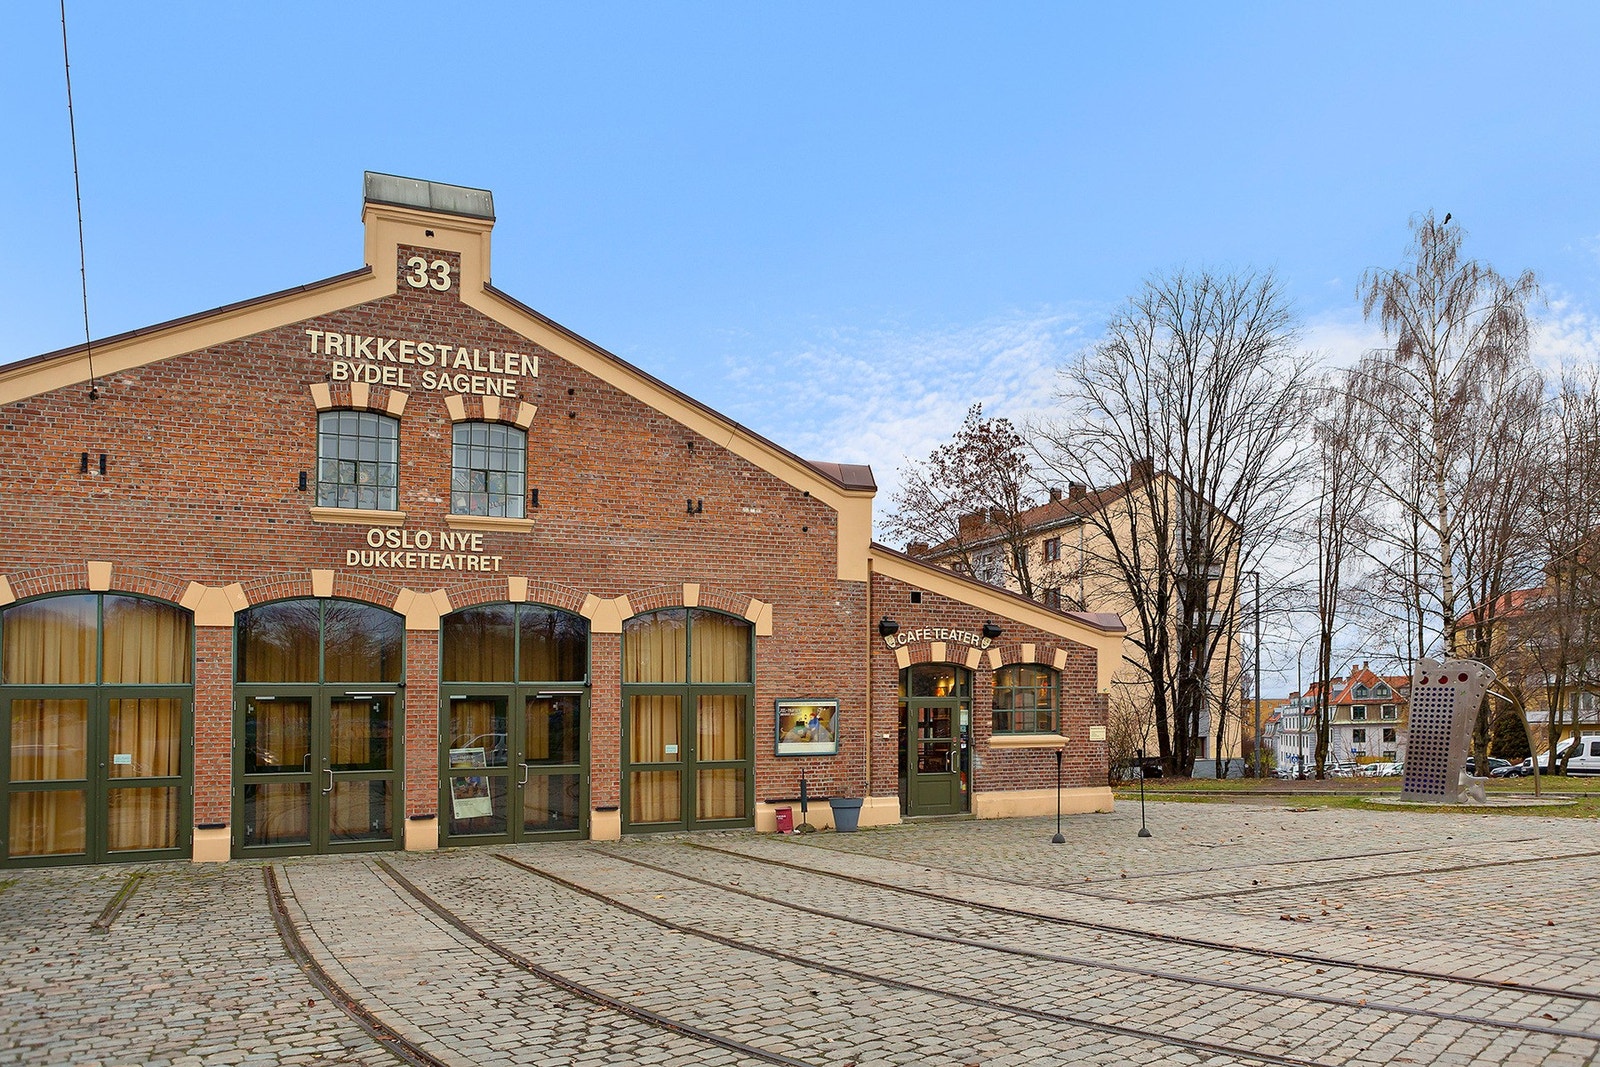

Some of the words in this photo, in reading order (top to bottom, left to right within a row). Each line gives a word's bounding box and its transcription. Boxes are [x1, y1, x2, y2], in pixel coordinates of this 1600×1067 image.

[406, 256, 452, 292] 33
[305, 330, 540, 378] TRIKKESTALLEN
[332, 361, 412, 388] BYDEL
[421, 371, 517, 398] SAGENE
[366, 528, 433, 550] OSLO
[440, 532, 484, 552] NYE
[346, 550, 503, 572] DUKKETEATRET
[897, 625, 932, 645] CAFÉ
[933, 628, 980, 647] TEATER
